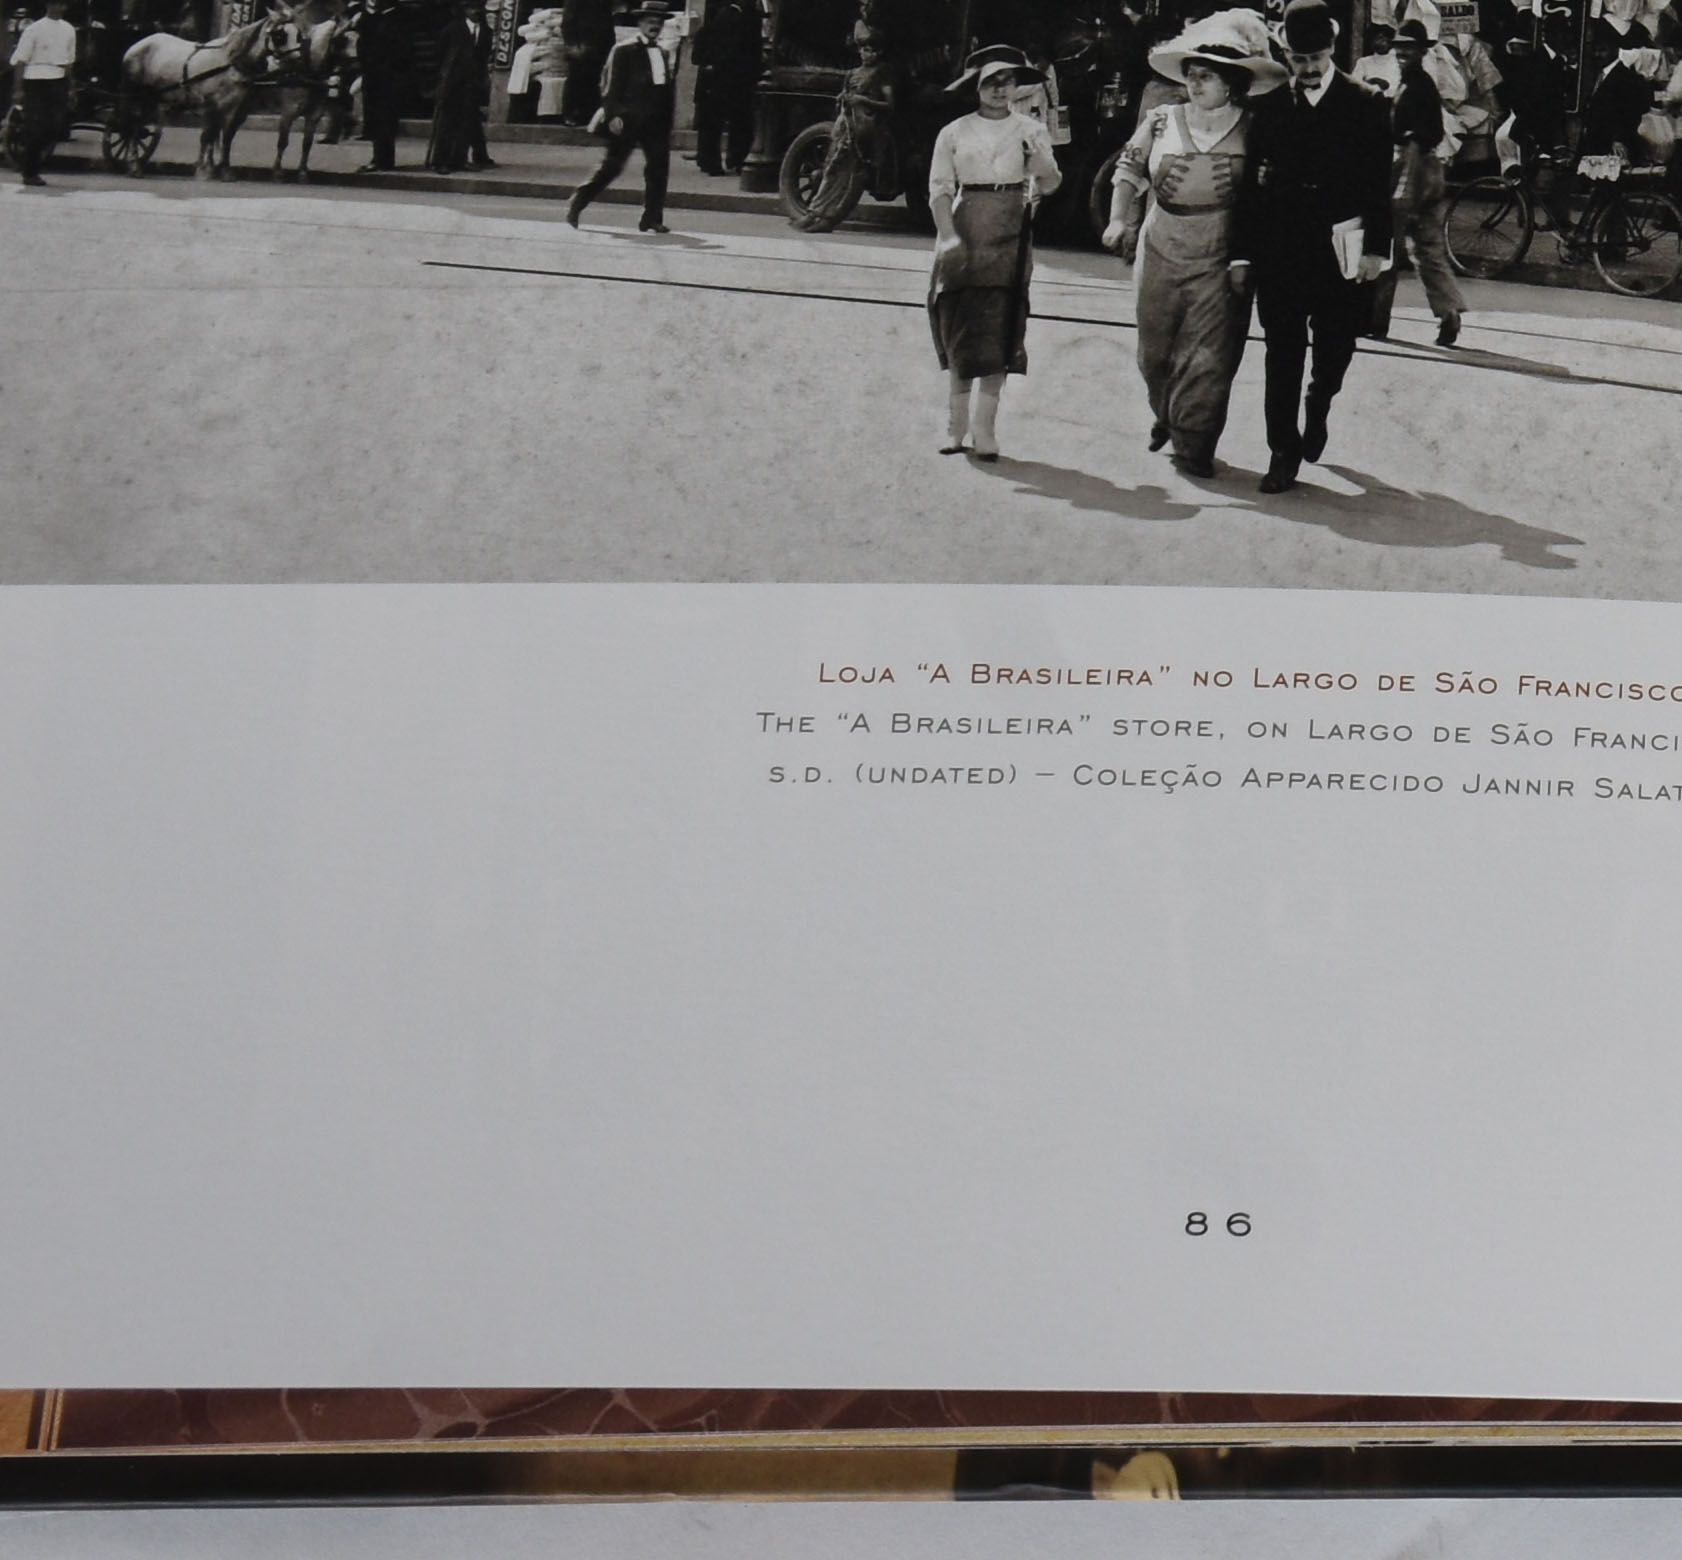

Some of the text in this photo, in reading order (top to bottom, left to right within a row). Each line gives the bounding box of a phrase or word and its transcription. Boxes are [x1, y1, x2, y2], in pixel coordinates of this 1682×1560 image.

[818, 662, 896, 684] LOJA
[917, 663, 951, 684] “A
[970, 663, 1171, 686] BRASILEIRA”
[1192, 670, 1233, 688] NO
[1253, 667, 1358, 691] LARGO
[1377, 674, 1416, 692] DE
[1434, 670, 1498, 695] SÃO
[755, 711, 816, 733] THE
[837, 712, 871, 734] “A
[891, 712, 1091, 736] BRASILEIRA”
[1112, 718, 1225, 741] STORE,
[1247, 721, 1288, 739] ON
[1308, 720, 1413, 742] LARGO
[1433, 726, 1471, 744] DE
[1490, 724, 1554, 747] SÃO
[768, 766, 832, 784] S.D.
[855, 762, 1017, 785] (UNDATED)
[1073, 766, 1222, 795] COLEÇÃO
[1240, 769, 1444, 793] APPARECIDO
[1462, 773, 1575, 797] JANNIR
[1184, 1211, 1252, 1238] 86
